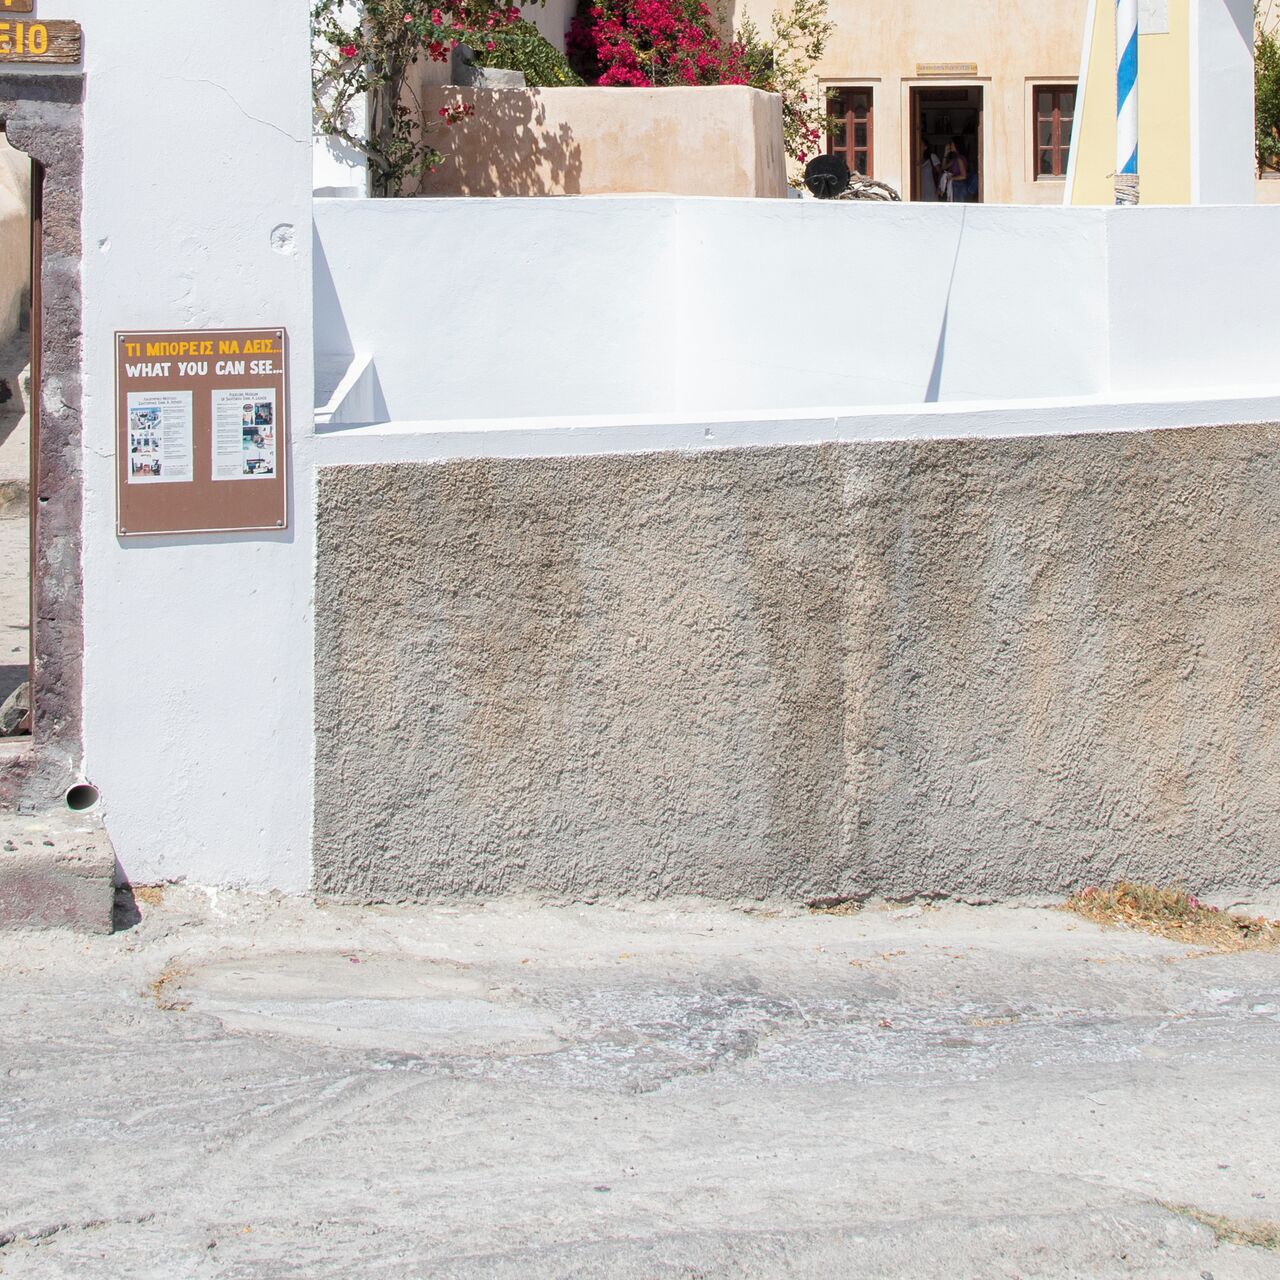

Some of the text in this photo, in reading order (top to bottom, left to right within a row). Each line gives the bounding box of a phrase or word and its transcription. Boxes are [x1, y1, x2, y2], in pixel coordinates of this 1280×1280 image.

[125, 343, 141, 357] ΤΙ
[146, 341, 213, 356] ΜΠΟΡΕΙΣ
[219, 340, 240, 354] ΝΑ
[125, 359, 283, 377] WHAT YOU CAN SEE...
